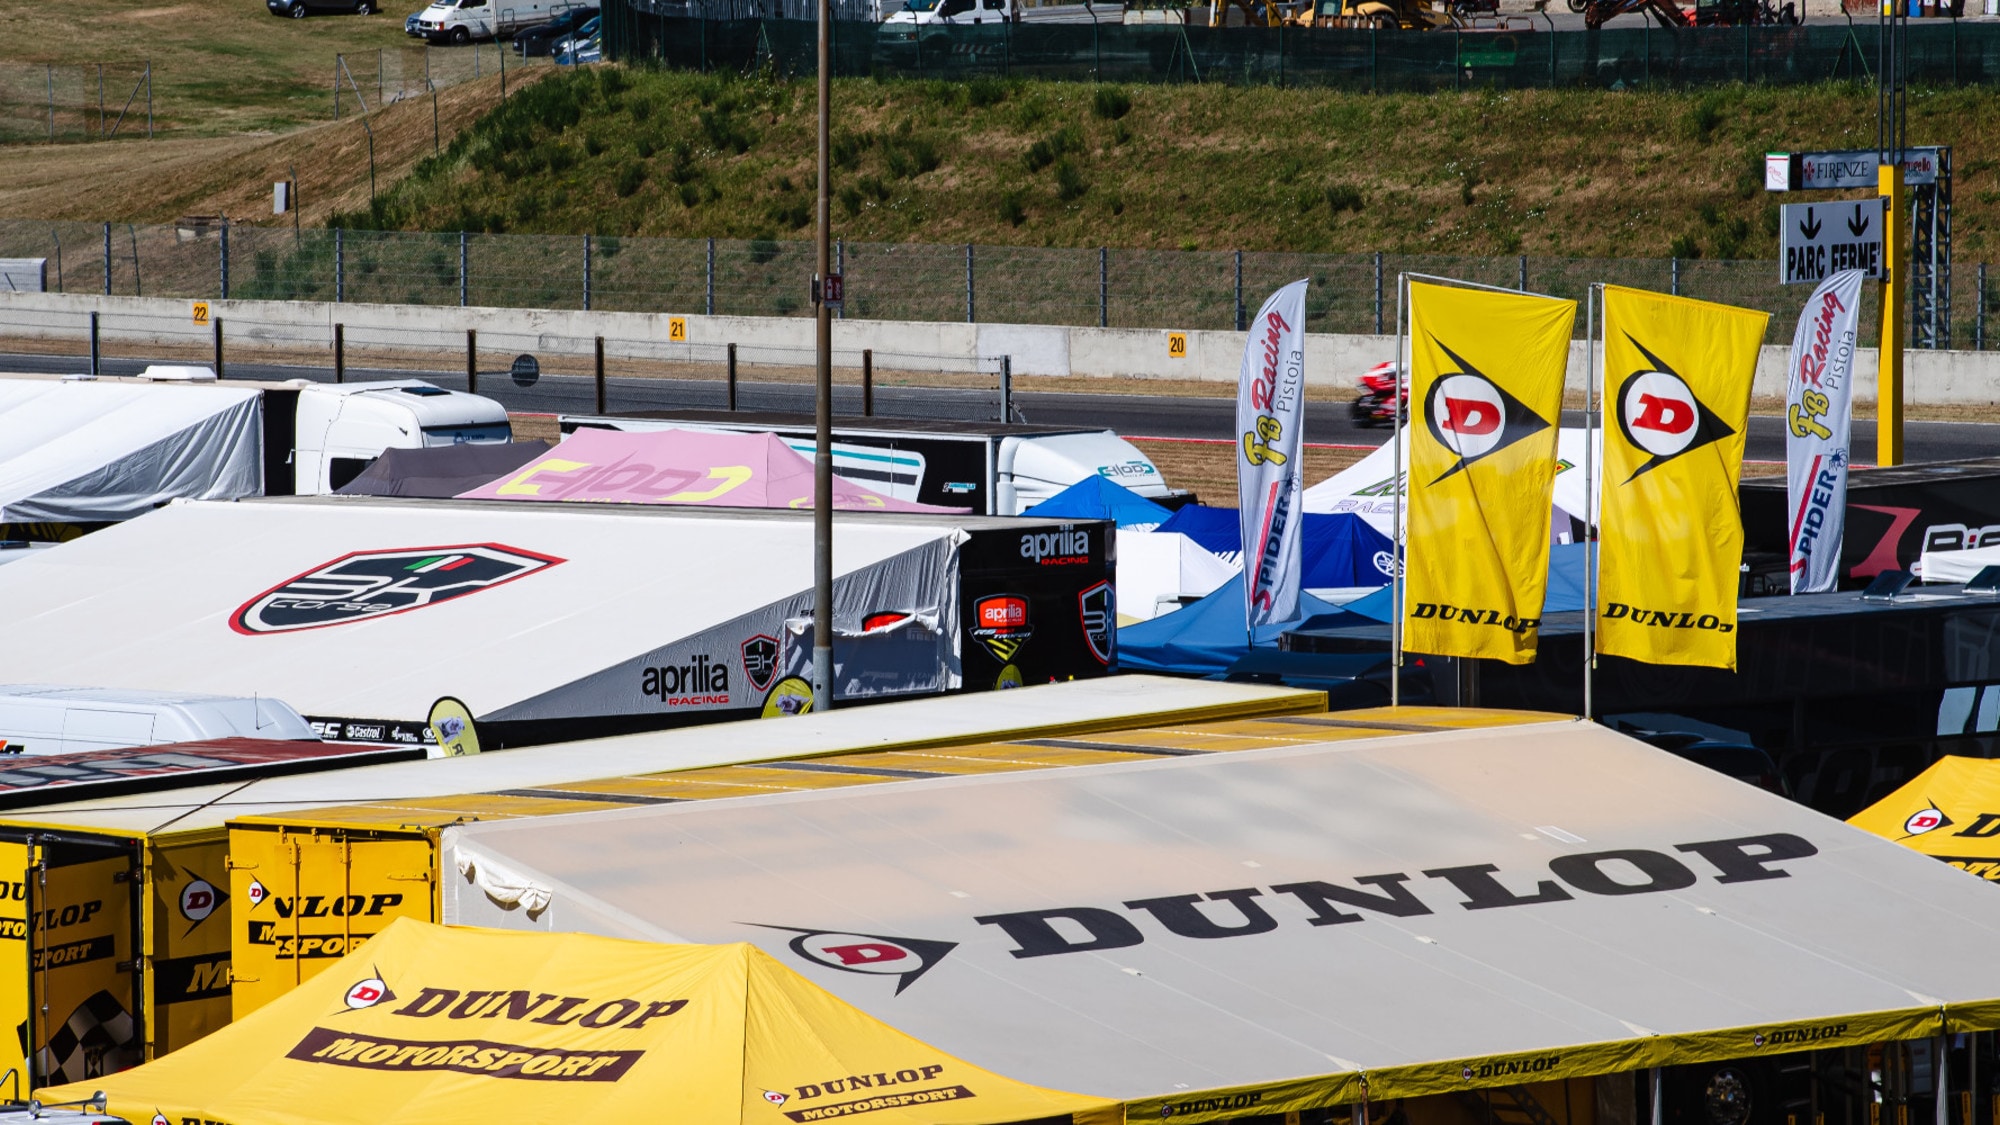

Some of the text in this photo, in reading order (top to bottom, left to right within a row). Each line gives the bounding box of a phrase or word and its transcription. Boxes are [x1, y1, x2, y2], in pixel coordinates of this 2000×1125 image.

[1816, 160, 1870, 182] FIRENZE
[1788, 246, 1825, 281] PARC
[194, 306, 207, 321] 22
[671, 321, 683, 337] 21
[1170, 336, 1184, 353] 20
[1800, 288, 1845, 389] Racing
[1252, 310, 1291, 413] Racing
[1825, 330, 1855, 391] Pistoia
[1276, 350, 1303, 413] Pistoia
[1020, 524, 1089, 563] aprilia
[1041, 556, 1089, 566] RACING
[984, 604, 1022, 622] aprilia
[641, 655, 729, 702] aprilia
[668, 694, 729, 706] RACING
[354, 727, 382, 739] Castrol
[973, 832, 1819, 959] DUNLOP
[391, 987, 690, 1030] DUNLOP
[1769, 1023, 1848, 1044] DUNLOP
[312, 1037, 617, 1078] MOTORSPORT
[1478, 1057, 1561, 1079] DUNLOP
[794, 1064, 944, 1100] DUNLOP
[801, 1087, 958, 1121] MOTORSPORT
[1178, 1093, 1262, 1116] DUNLOP
